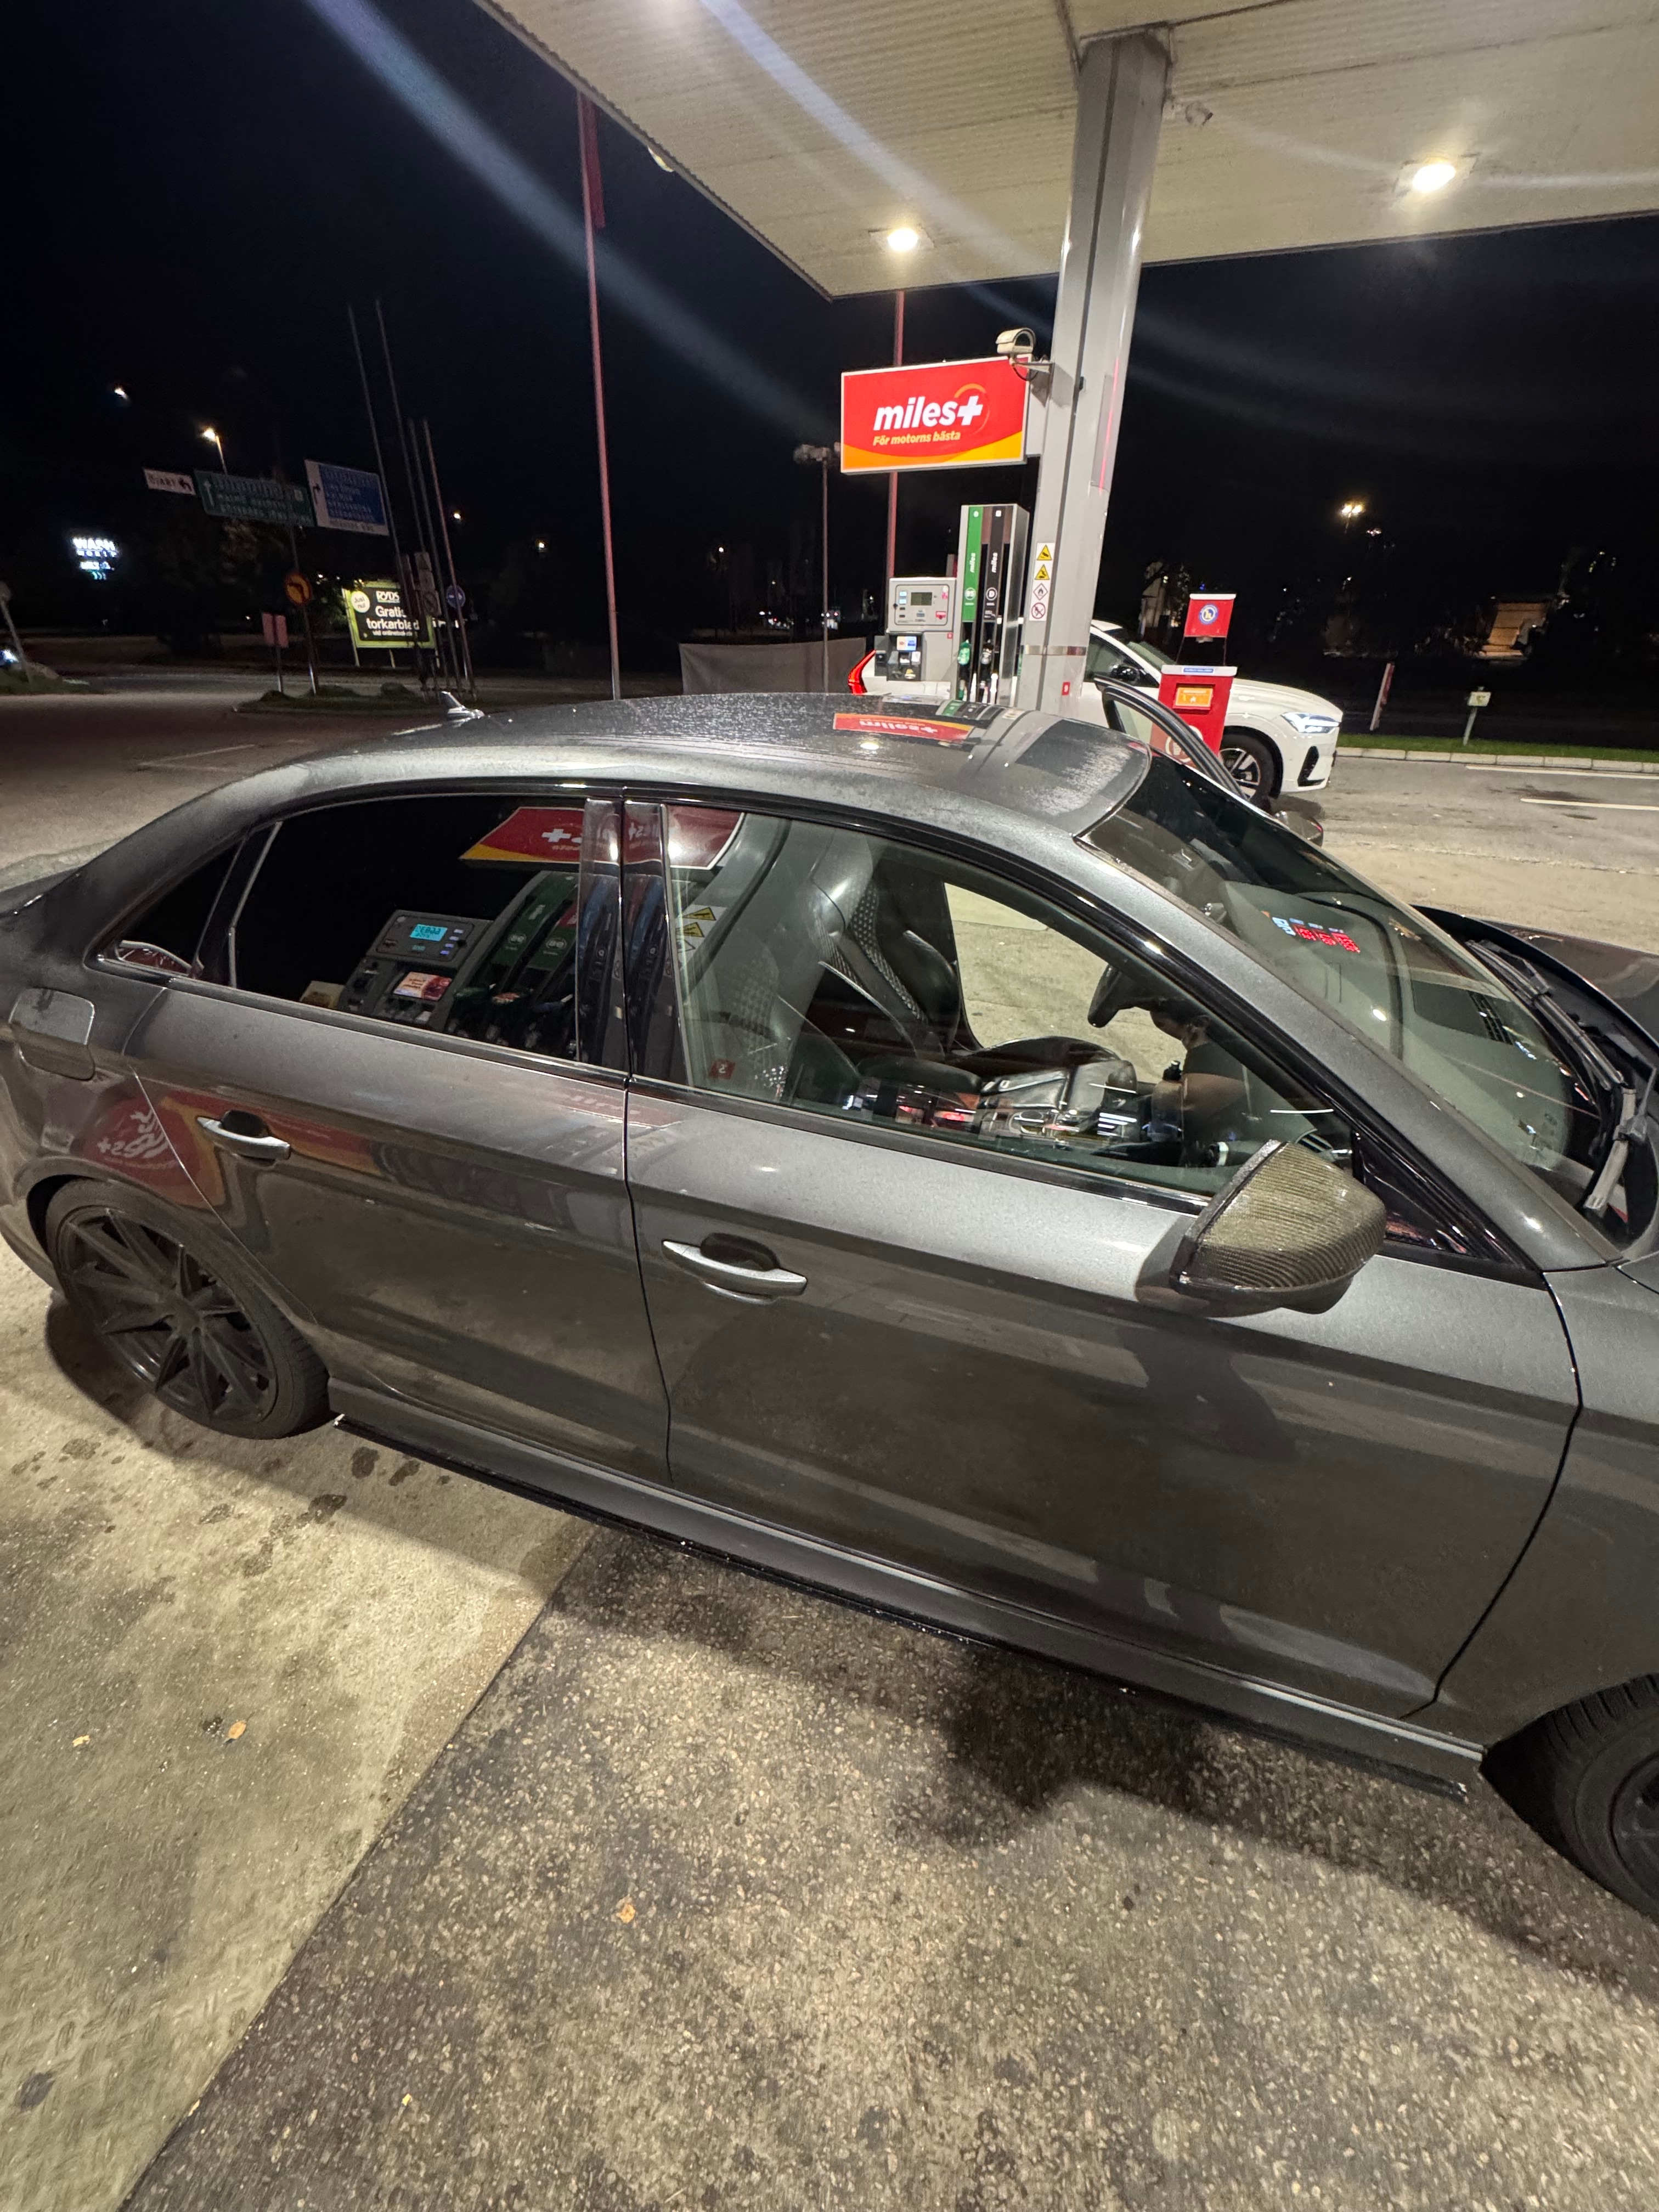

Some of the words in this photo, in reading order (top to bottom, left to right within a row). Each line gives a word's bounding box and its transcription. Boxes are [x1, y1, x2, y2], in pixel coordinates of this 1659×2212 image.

[873, 395, 984, 431] miles+
[872, 435, 890, 446] För
[890, 433, 932, 445] motorns
[933, 431, 961, 442] bästa
[376, 590, 400, 601] RYDS
